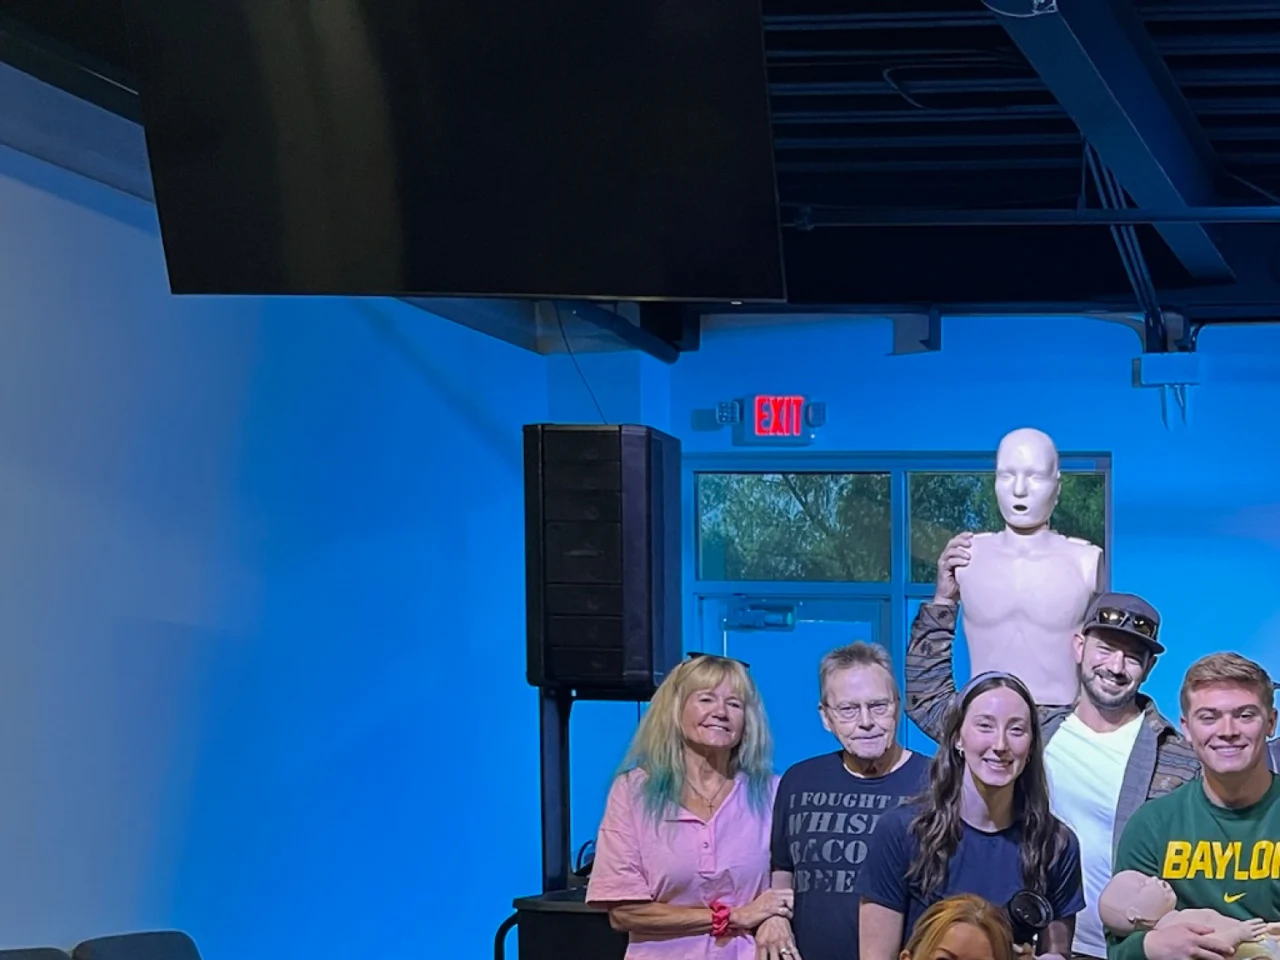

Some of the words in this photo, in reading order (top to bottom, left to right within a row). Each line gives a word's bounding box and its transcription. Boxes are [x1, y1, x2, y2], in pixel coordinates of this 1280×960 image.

[755, 395, 805, 436] EXIT
[789, 793, 797, 809] I
[800, 792, 892, 809] FOUGHT
[796, 868, 862, 893] BEE
